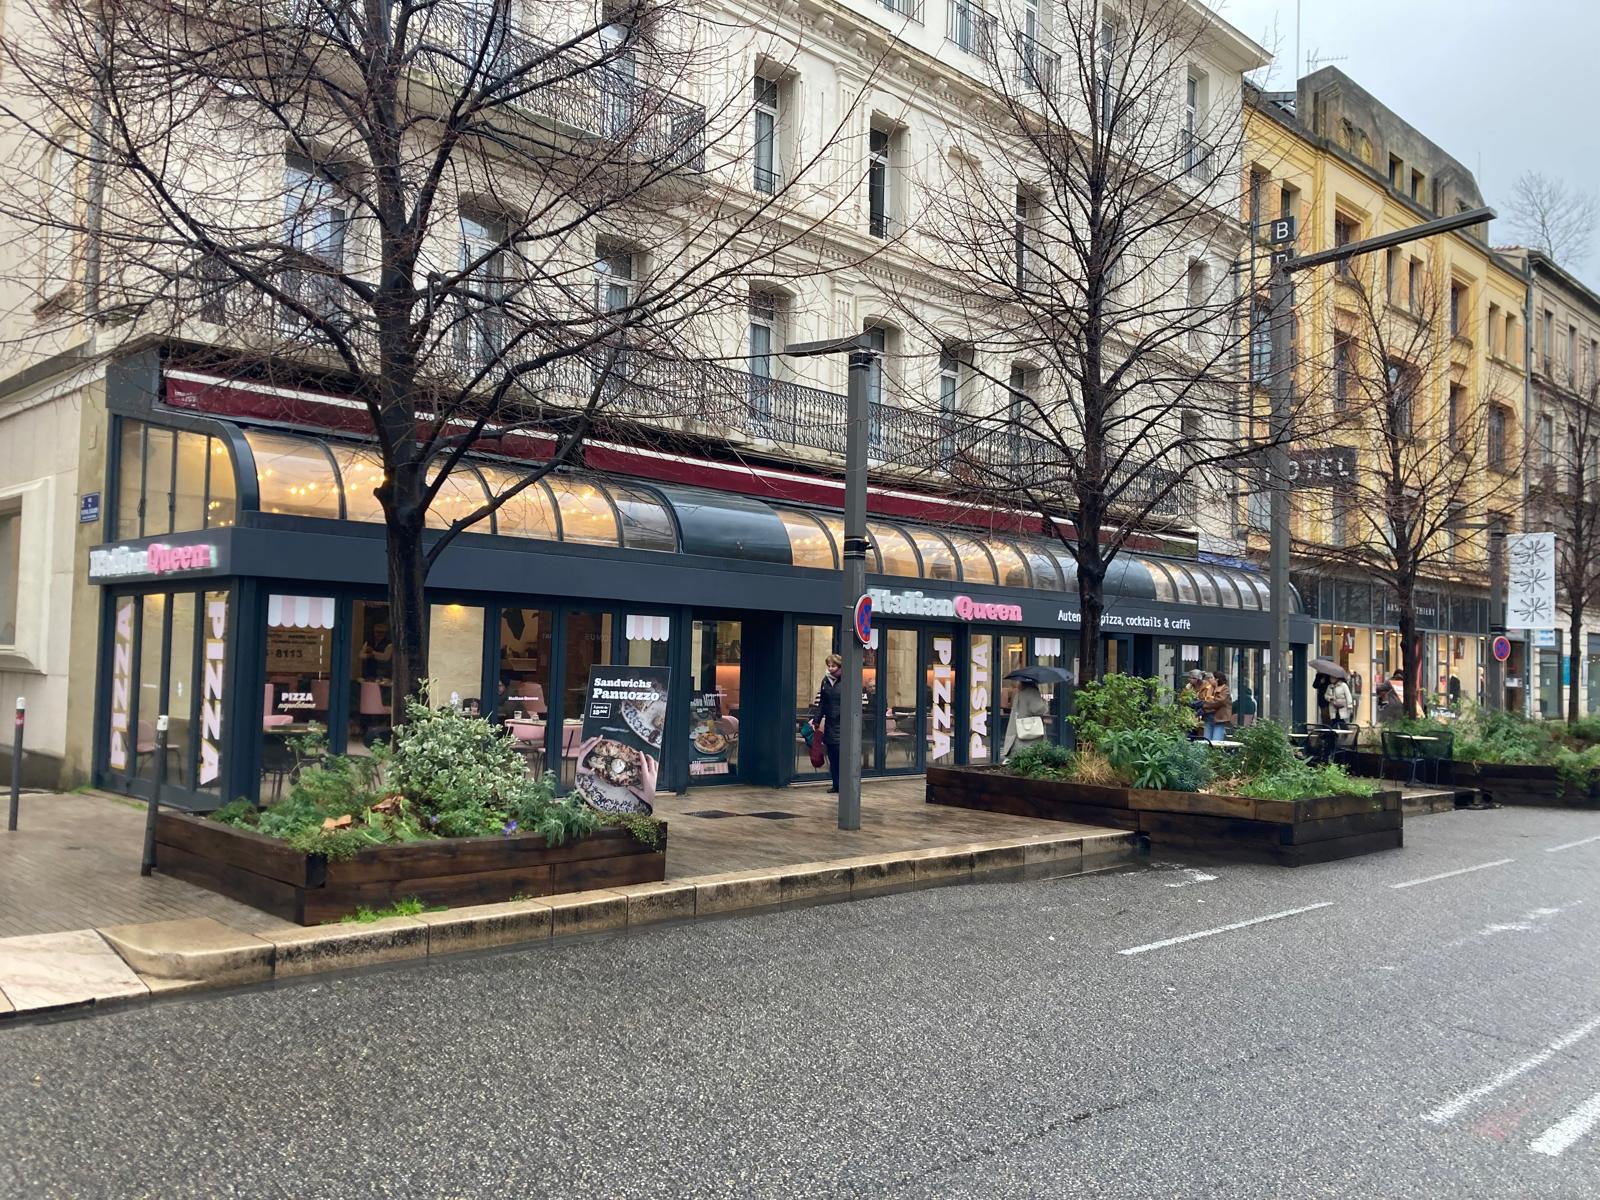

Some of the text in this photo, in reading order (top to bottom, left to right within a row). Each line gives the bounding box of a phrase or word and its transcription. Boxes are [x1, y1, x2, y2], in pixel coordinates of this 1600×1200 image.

[147, 543, 211, 575] Queen
[868, 588, 1023, 621] Italian Queen
[1100, 613, 1124, 627] pizza,
[1125, 615, 1161, 628] cocktails
[1163, 618, 1170, 629] &
[110, 602, 134, 770] PIZZA
[200, 600, 226, 786] PIZZA
[281, 692, 313, 701] PIZZA
[592, 687, 660, 700] Panuozzo
[594, 677, 652, 688] Sandwichs
[932, 637, 952, 760] PIZZA
[970, 641, 988, 759] PASTA
